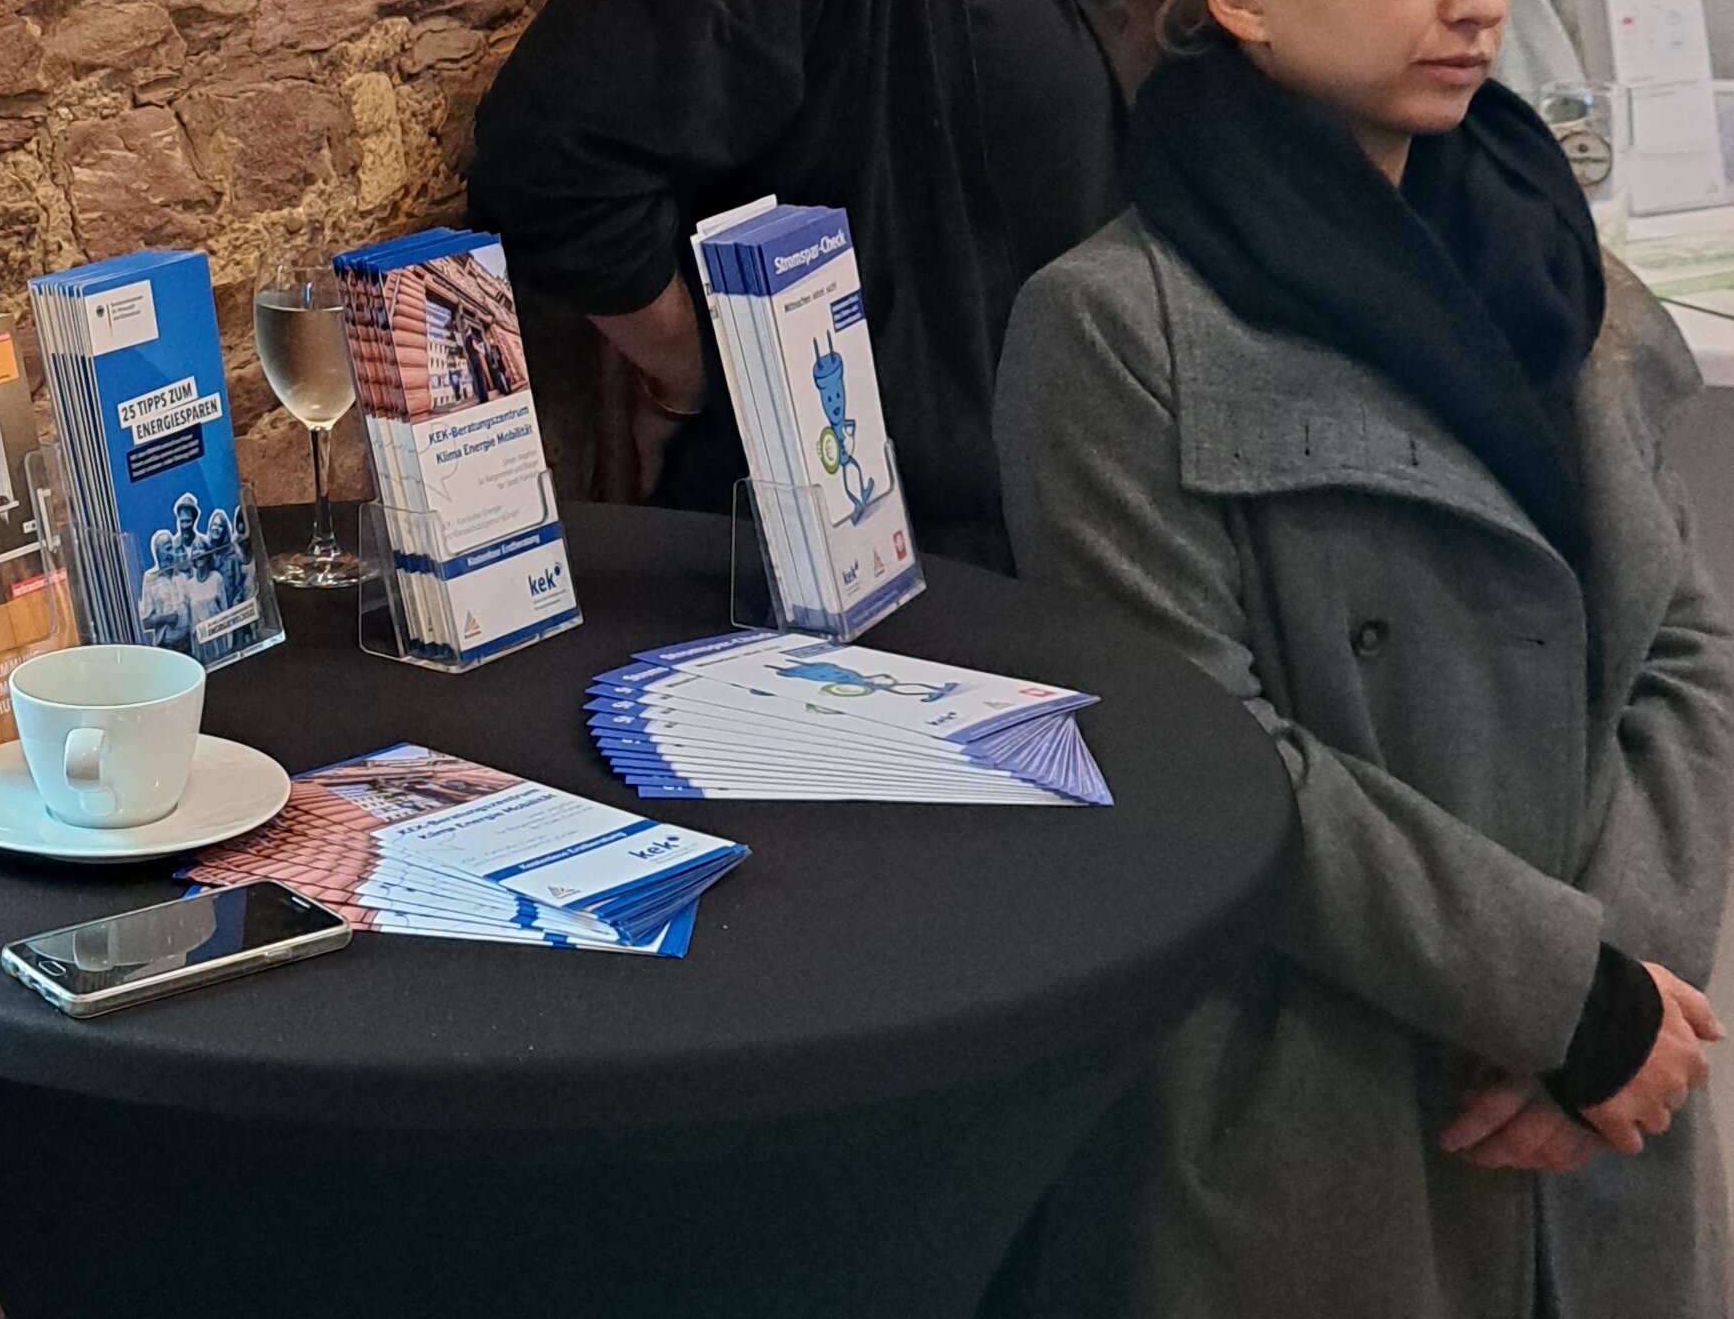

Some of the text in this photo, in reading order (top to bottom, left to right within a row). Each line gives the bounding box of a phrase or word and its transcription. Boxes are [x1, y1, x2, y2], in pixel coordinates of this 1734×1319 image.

[774, 229, 847, 275] Stromspar-Check
[122, 383, 193, 421] 25 TIPPS ZUM
[136, 398, 218, 439] ENERGIESPAREN
[428, 406, 530, 445] KEK-Beratungszentrum
[436, 424, 533, 464] Klima Energie Mobilität
[528, 569, 557, 596] kek
[628, 840, 679, 859] kek
